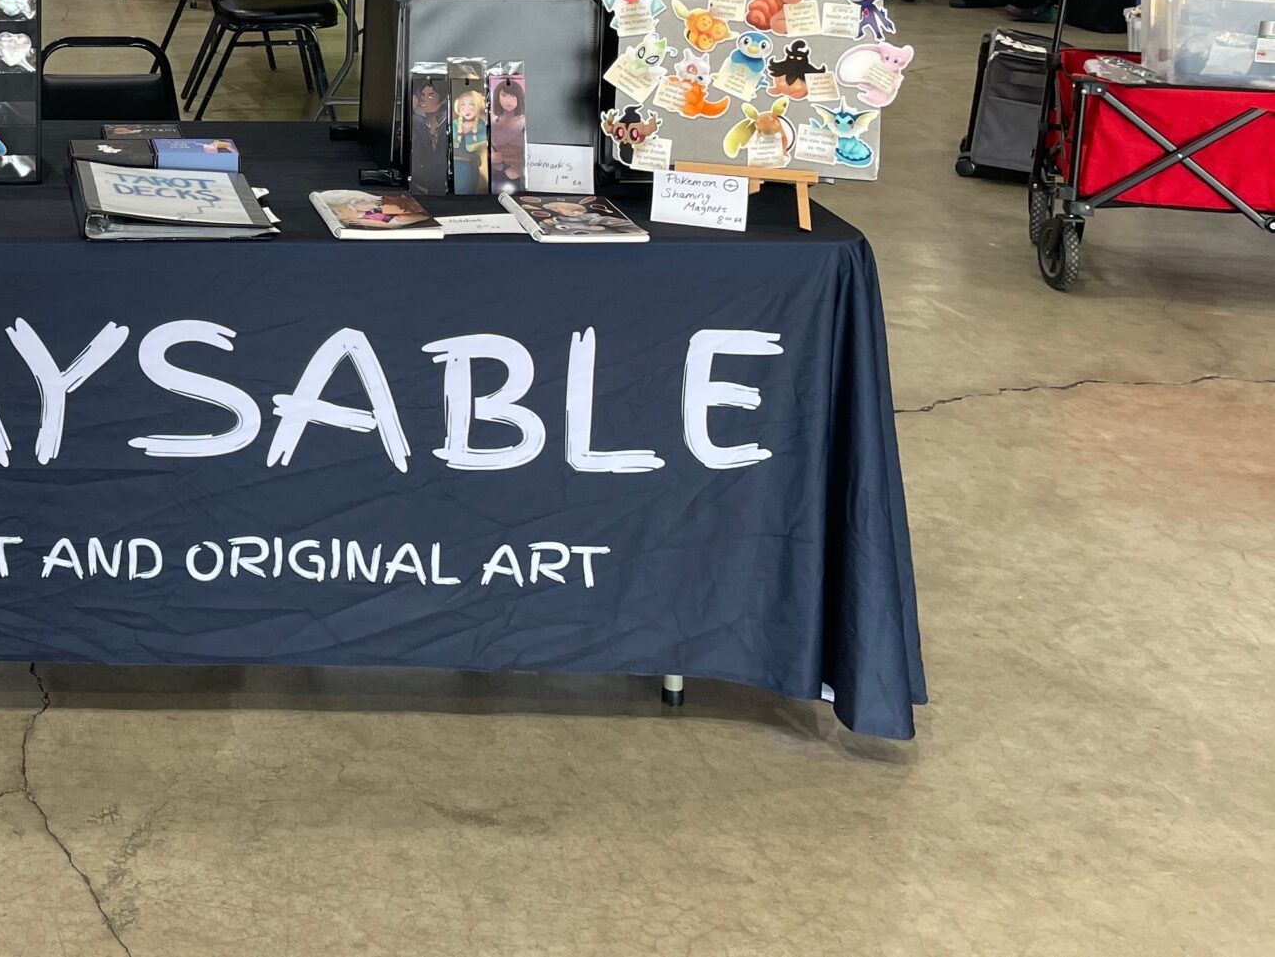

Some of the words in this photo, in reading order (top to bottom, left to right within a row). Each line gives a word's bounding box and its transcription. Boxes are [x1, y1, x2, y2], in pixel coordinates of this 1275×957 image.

[105, 171, 216, 189] TAROT
[666, 173, 718, 188] Pokemon
[112, 183, 222, 202] DECKS
[661, 187, 711, 205] Shaming
[683, 202, 729, 216] Magnets
[41, 537, 163, 580] AND
[185, 535, 461, 585] ORIGINAL
[480, 541, 611, 588] ART
